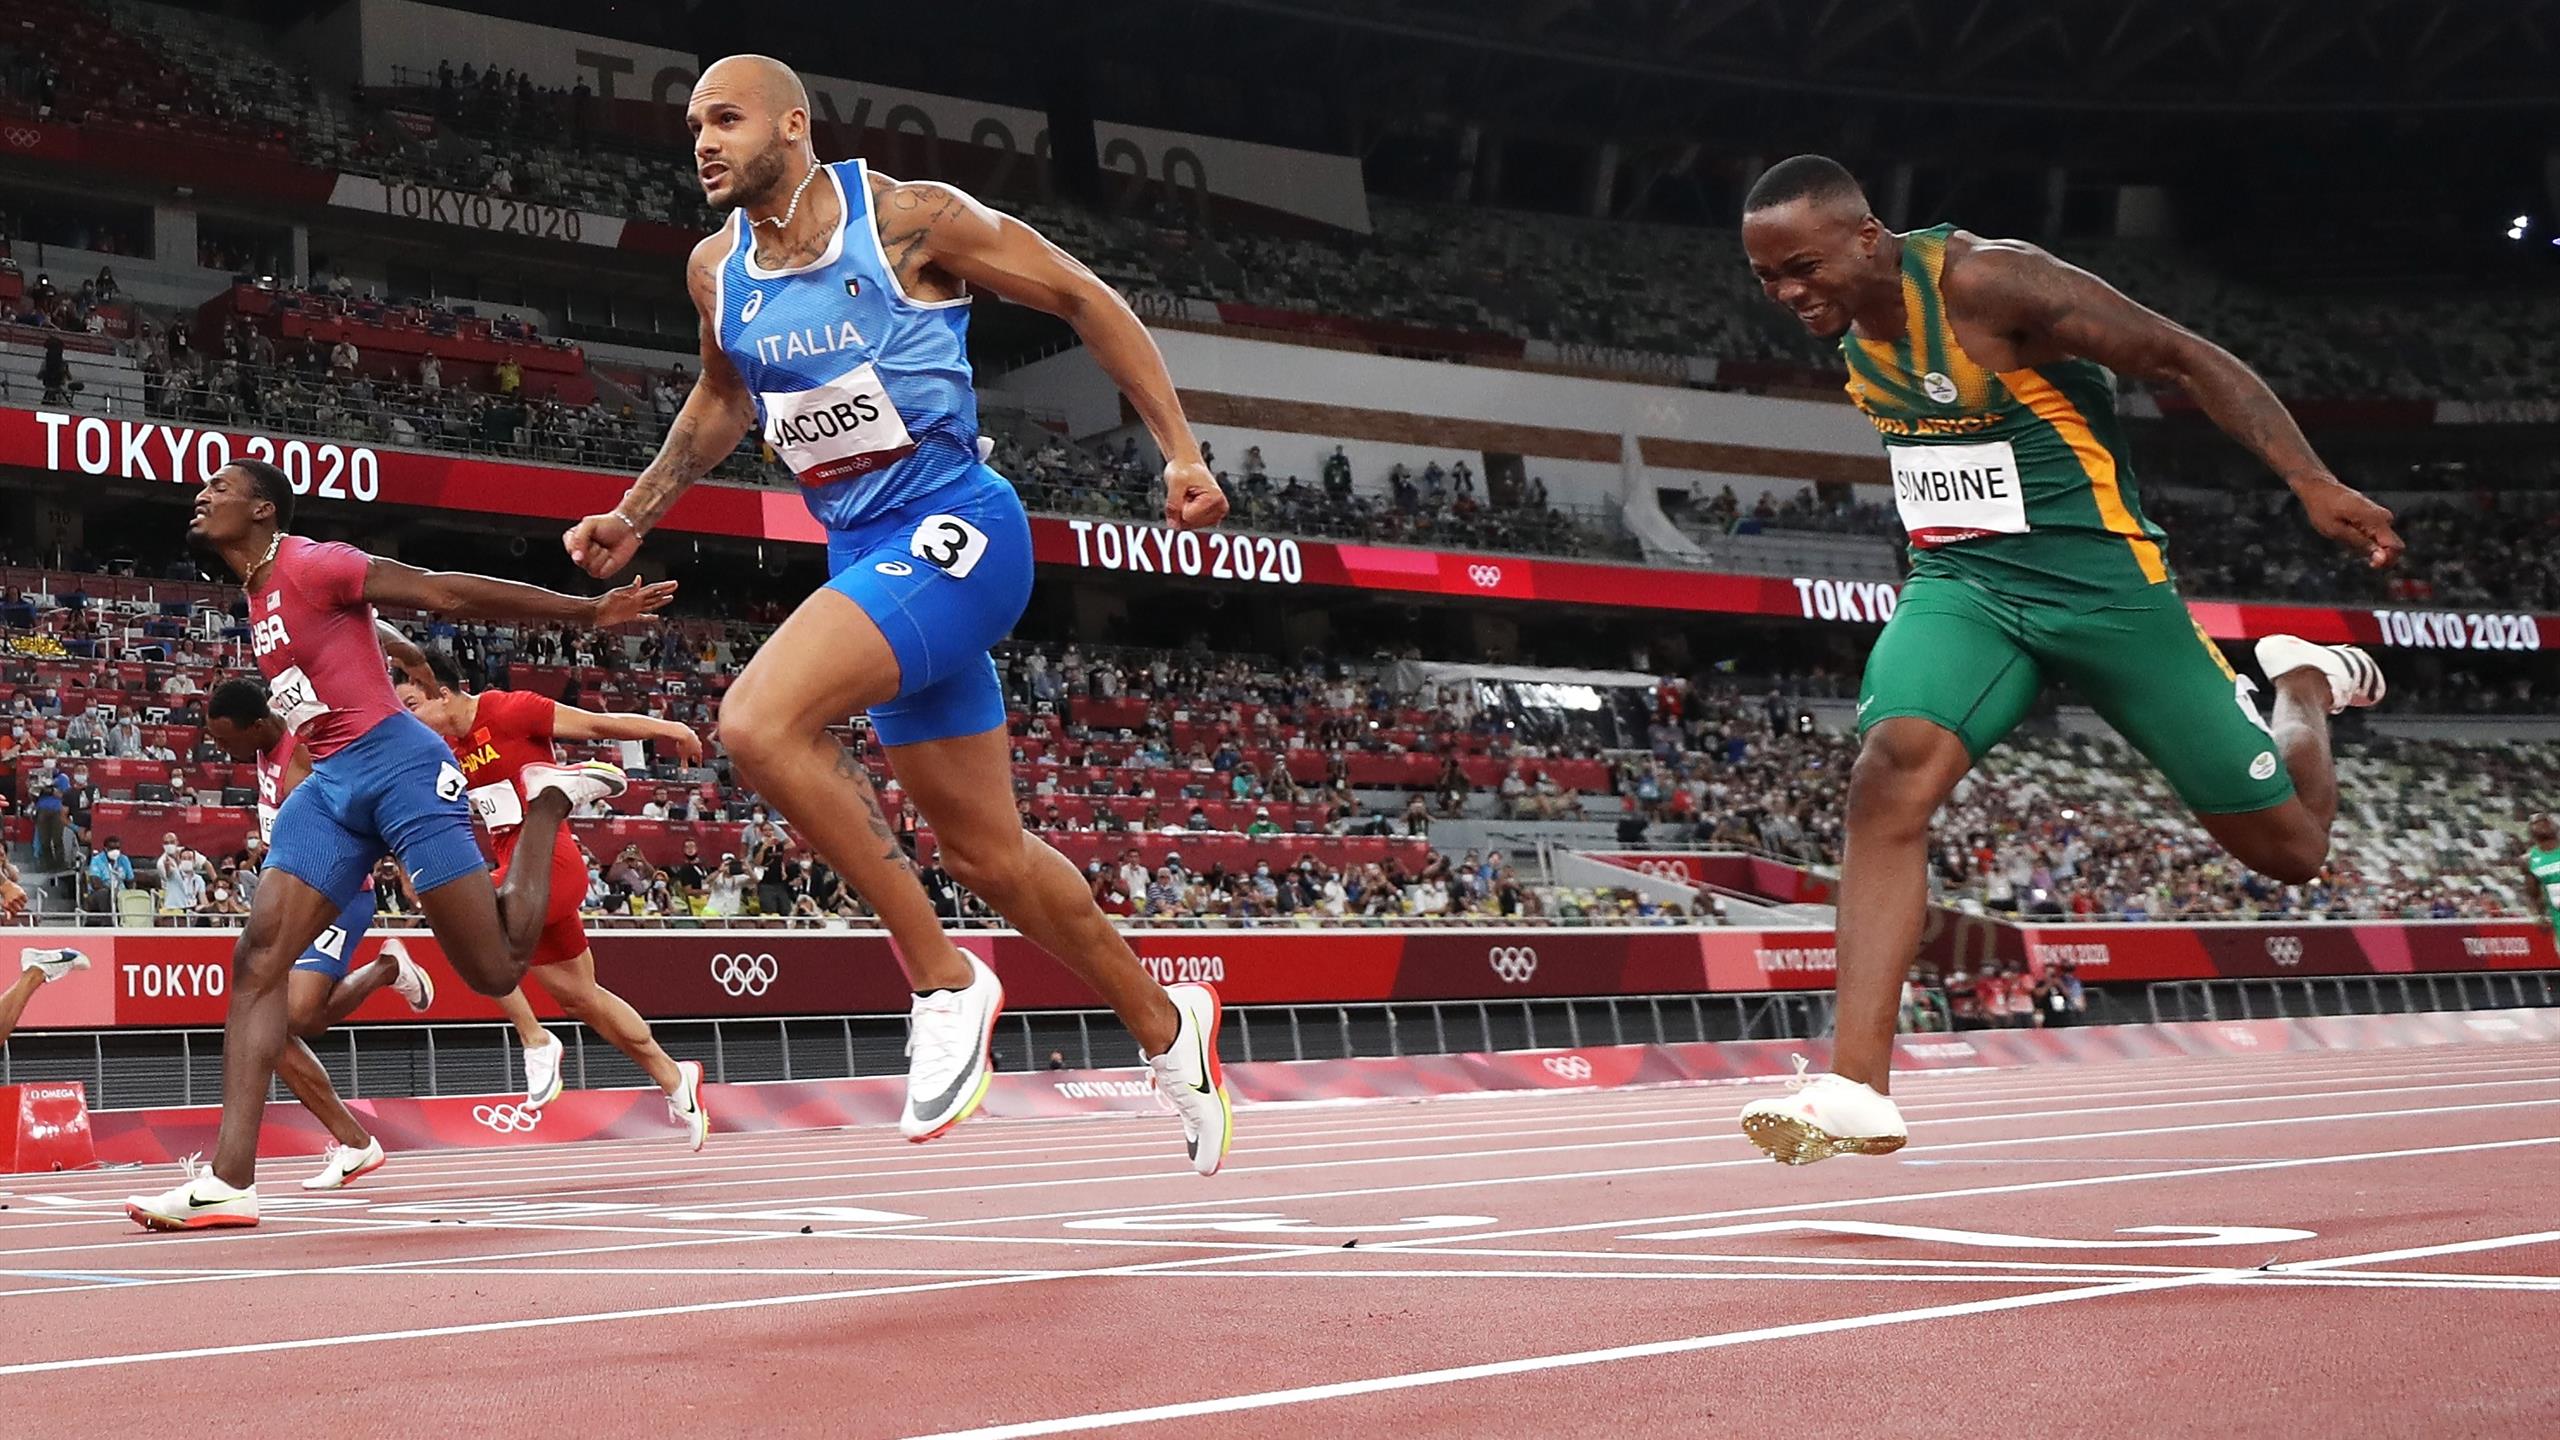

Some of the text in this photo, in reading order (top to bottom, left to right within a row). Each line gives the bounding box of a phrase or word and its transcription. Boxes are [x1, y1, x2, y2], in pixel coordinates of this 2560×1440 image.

[380, 182, 581, 243] TOKYO 2020
[756, 321, 865, 366] ITALIA
[774, 394, 880, 447] JACOBS
[35, 411, 230, 483] TOKYO
[1898, 467, 2008, 502] SIMBINE
[923, 522, 969, 569] 3
[1069, 520, 1303, 584] TOKYO 2020
[1792, 577, 1897, 623] TOKYO
[251, 614, 291, 657] USA
[2373, 610, 2541, 650] TOKYO 2020
[479, 797, 497, 816] SU
[327, 927, 339, 950] 7
[1176, 956, 1225, 982] 2020
[1753, 948, 1803, 971] TOKYO
[122, 963, 226, 997] TOKYO
[41, 1088, 75, 1099] OMEGA
[1054, 1081, 1118, 1099] TOKYO
